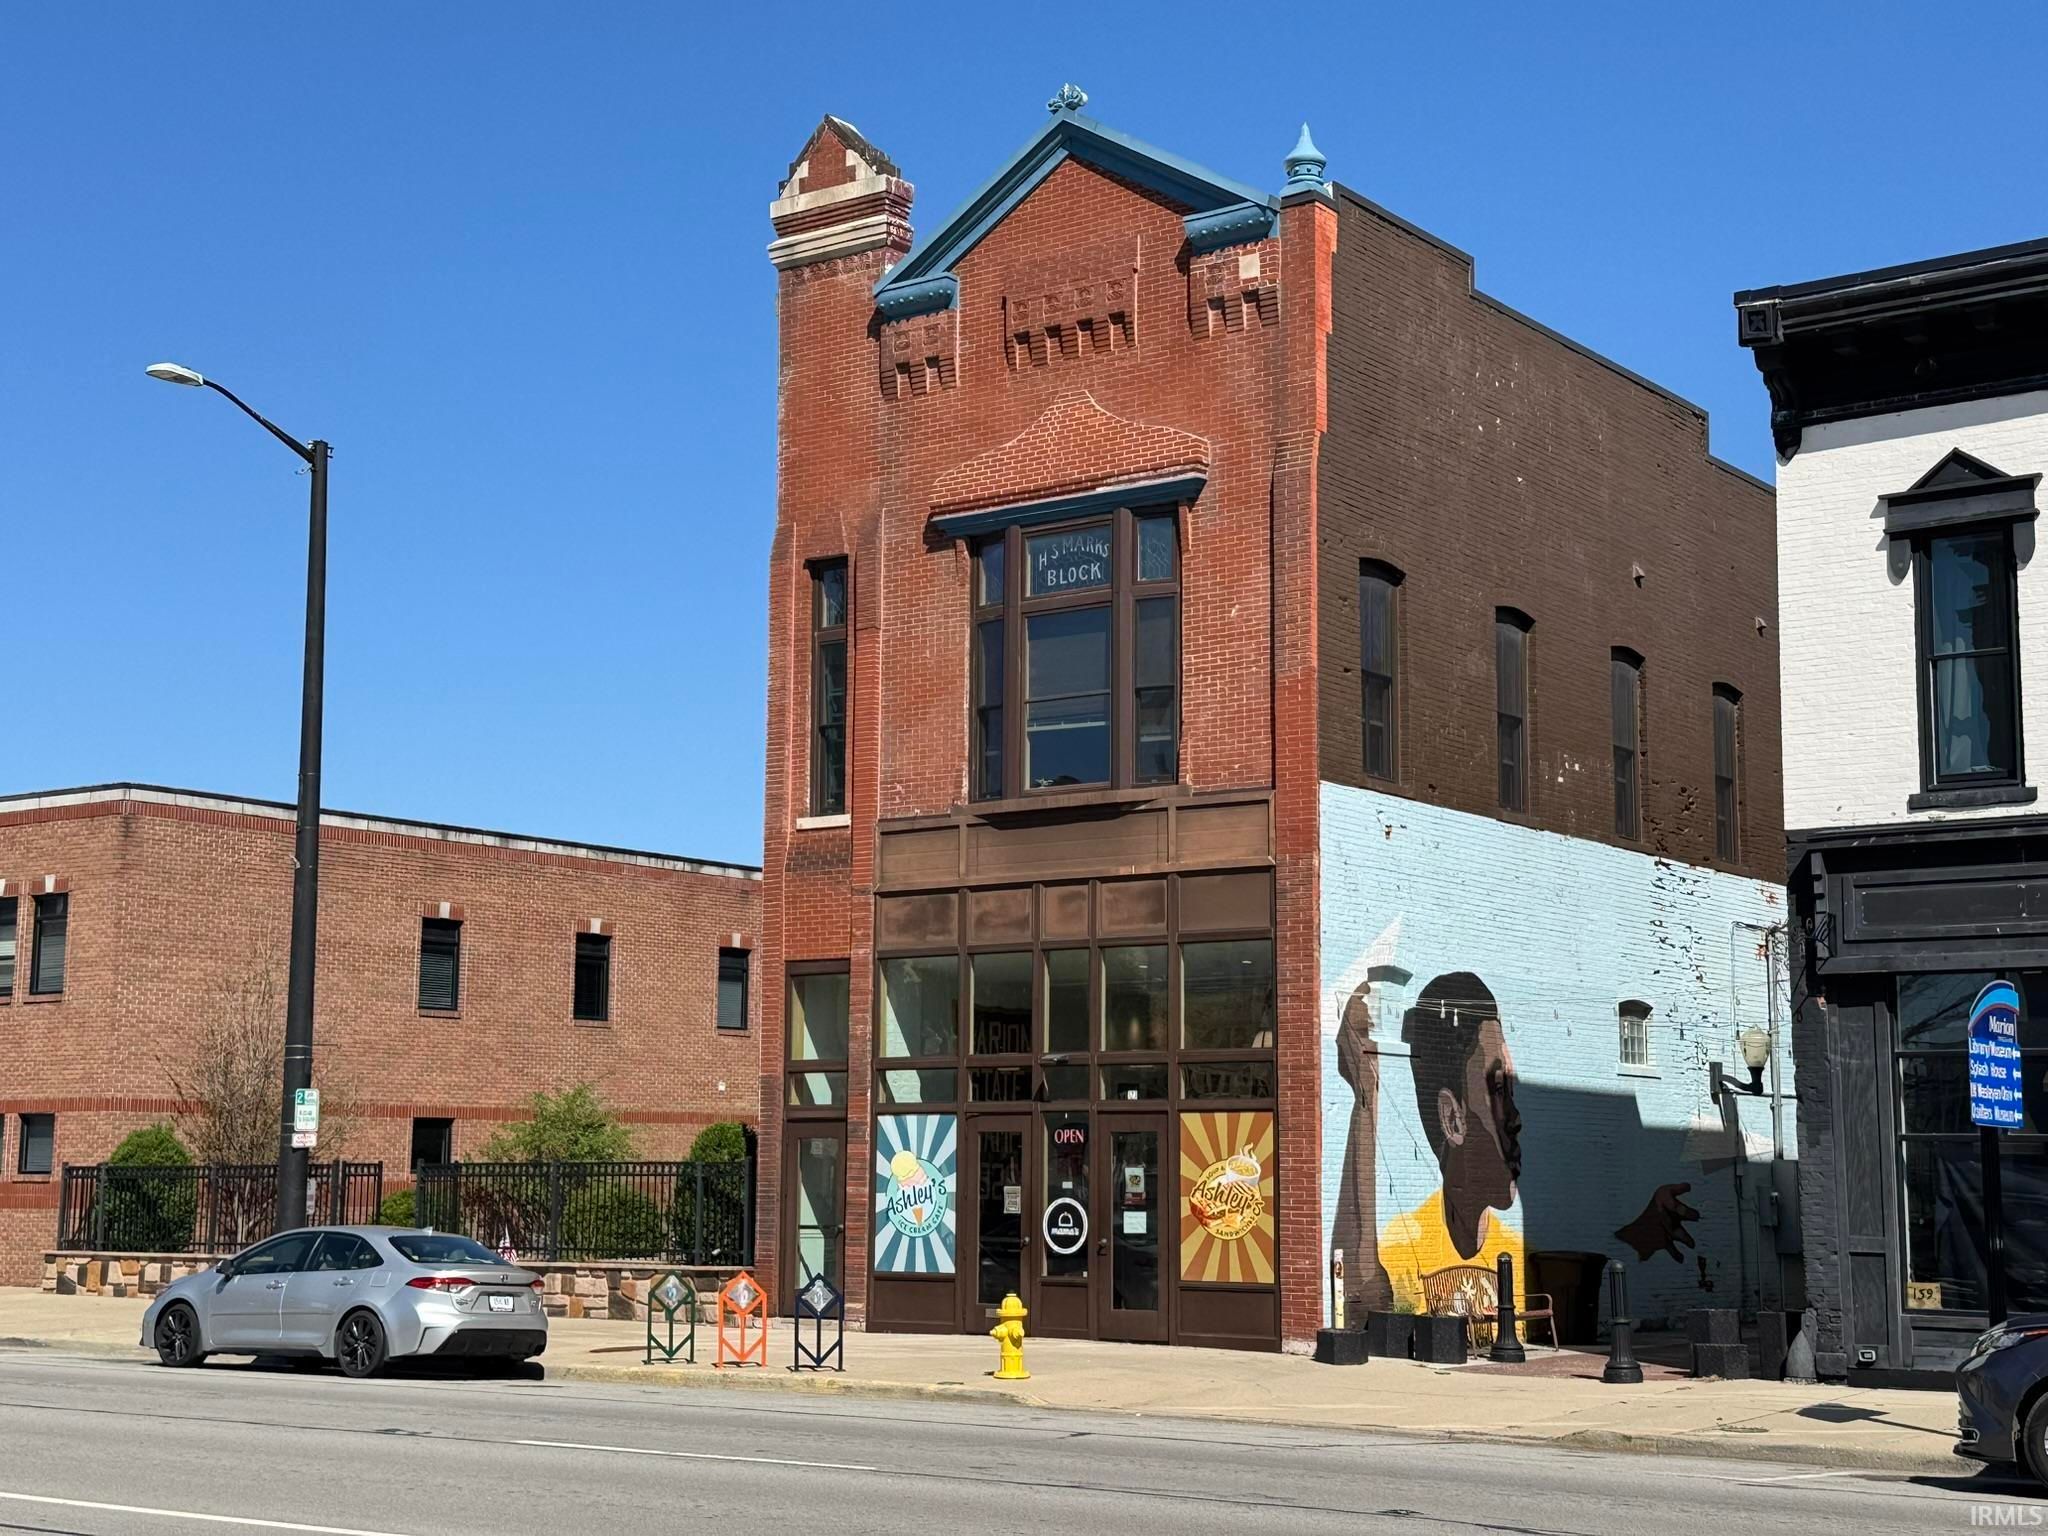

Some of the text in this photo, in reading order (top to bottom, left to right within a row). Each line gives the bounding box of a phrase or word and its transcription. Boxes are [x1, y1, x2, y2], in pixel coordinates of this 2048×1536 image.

[1038, 535, 1110, 571] H S MARKS
[1047, 562, 1101, 586] BLOCK
[974, 1019, 1032, 1054] ARION
[1989, 1015, 2014, 1037] Marion
[297, 1092, 303, 1104] 2
[1054, 1128, 1084, 1144] OPEN
[887, 1178, 947, 1215] Ashley's
[1191, 1180, 1264, 1216] Ashley's
[909, 1223, 932, 1234] CREAM
[1912, 1287, 1934, 1300] 159
